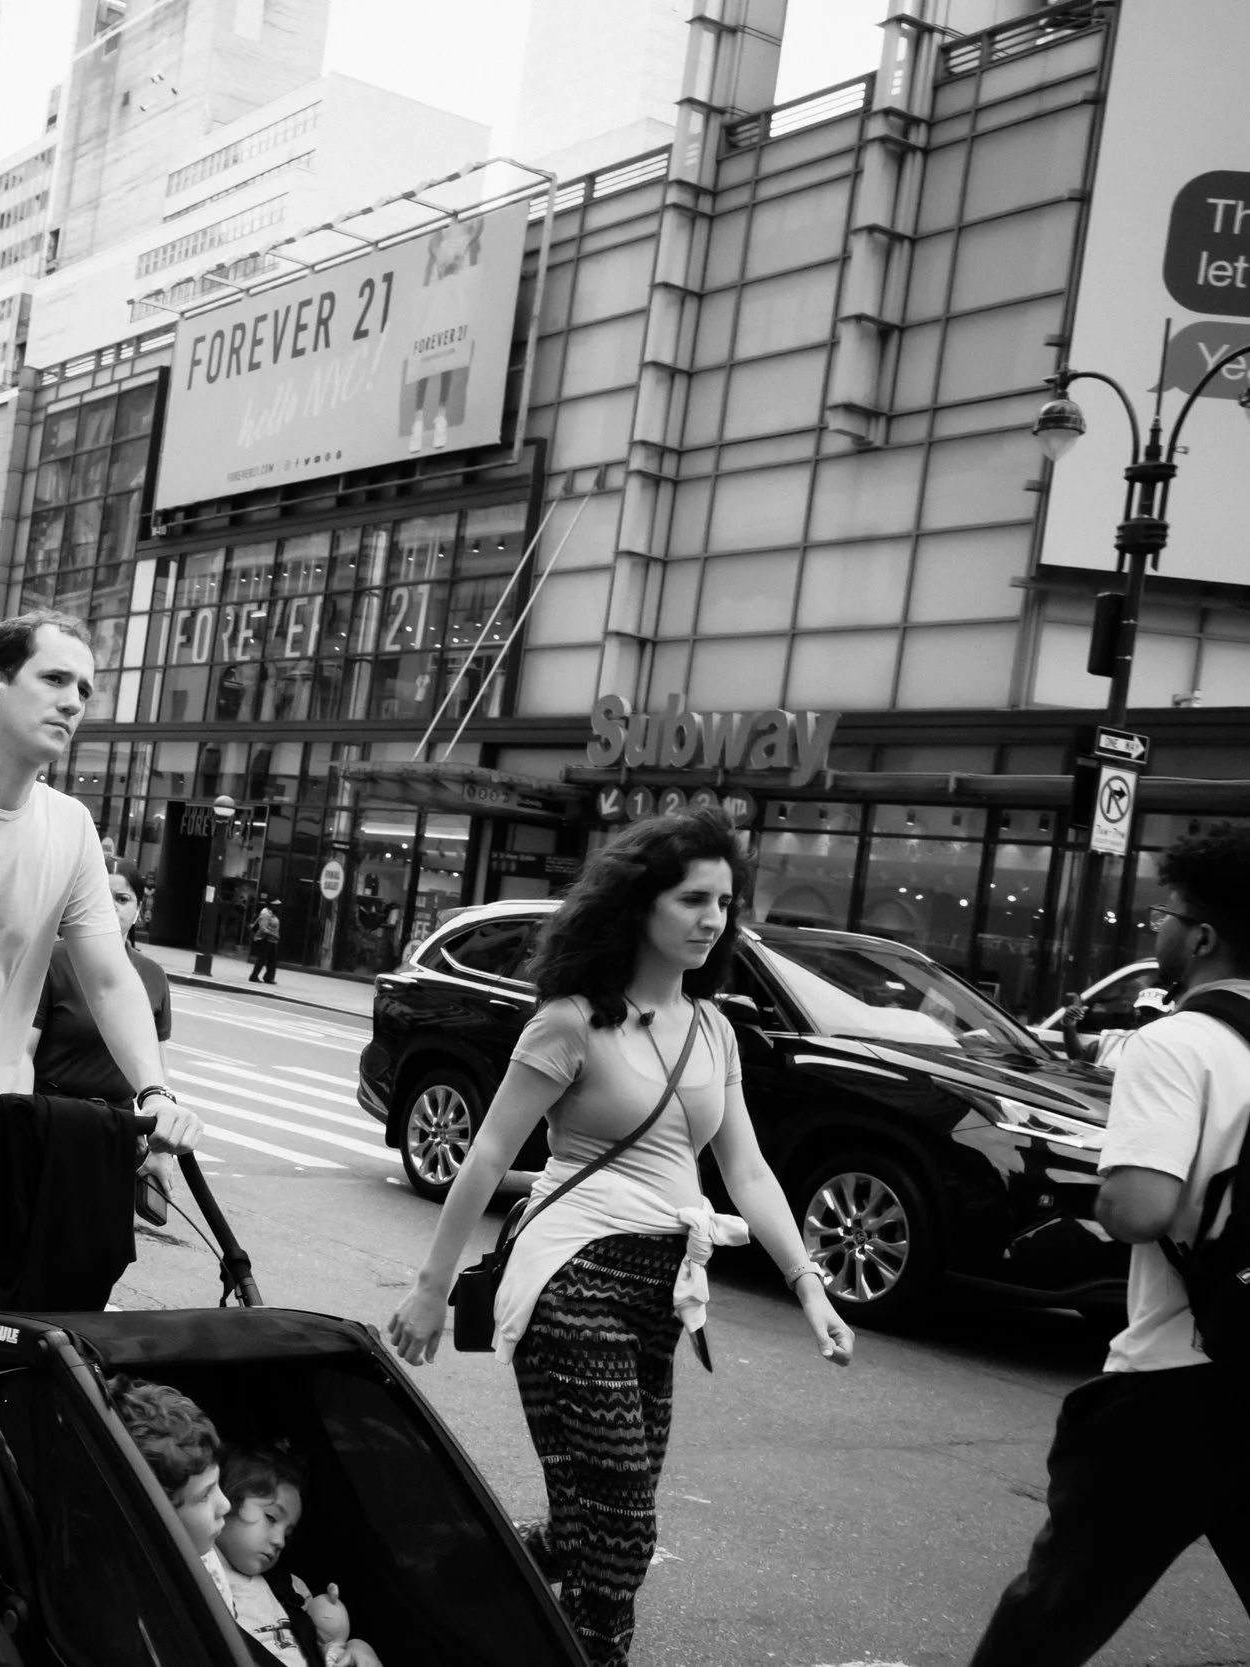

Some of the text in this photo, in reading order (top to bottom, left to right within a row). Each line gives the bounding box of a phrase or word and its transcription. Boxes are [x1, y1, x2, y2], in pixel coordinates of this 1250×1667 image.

[186, 271, 395, 391] FOREVER 21
[1198, 341, 1250, 381] Ye
[384, 583, 431, 652] 21
[587, 693, 842, 787] Subway
[1104, 736, 1119, 749] ONE
[633, 792, 643, 815] 1
[666, 793, 679, 815] 2
